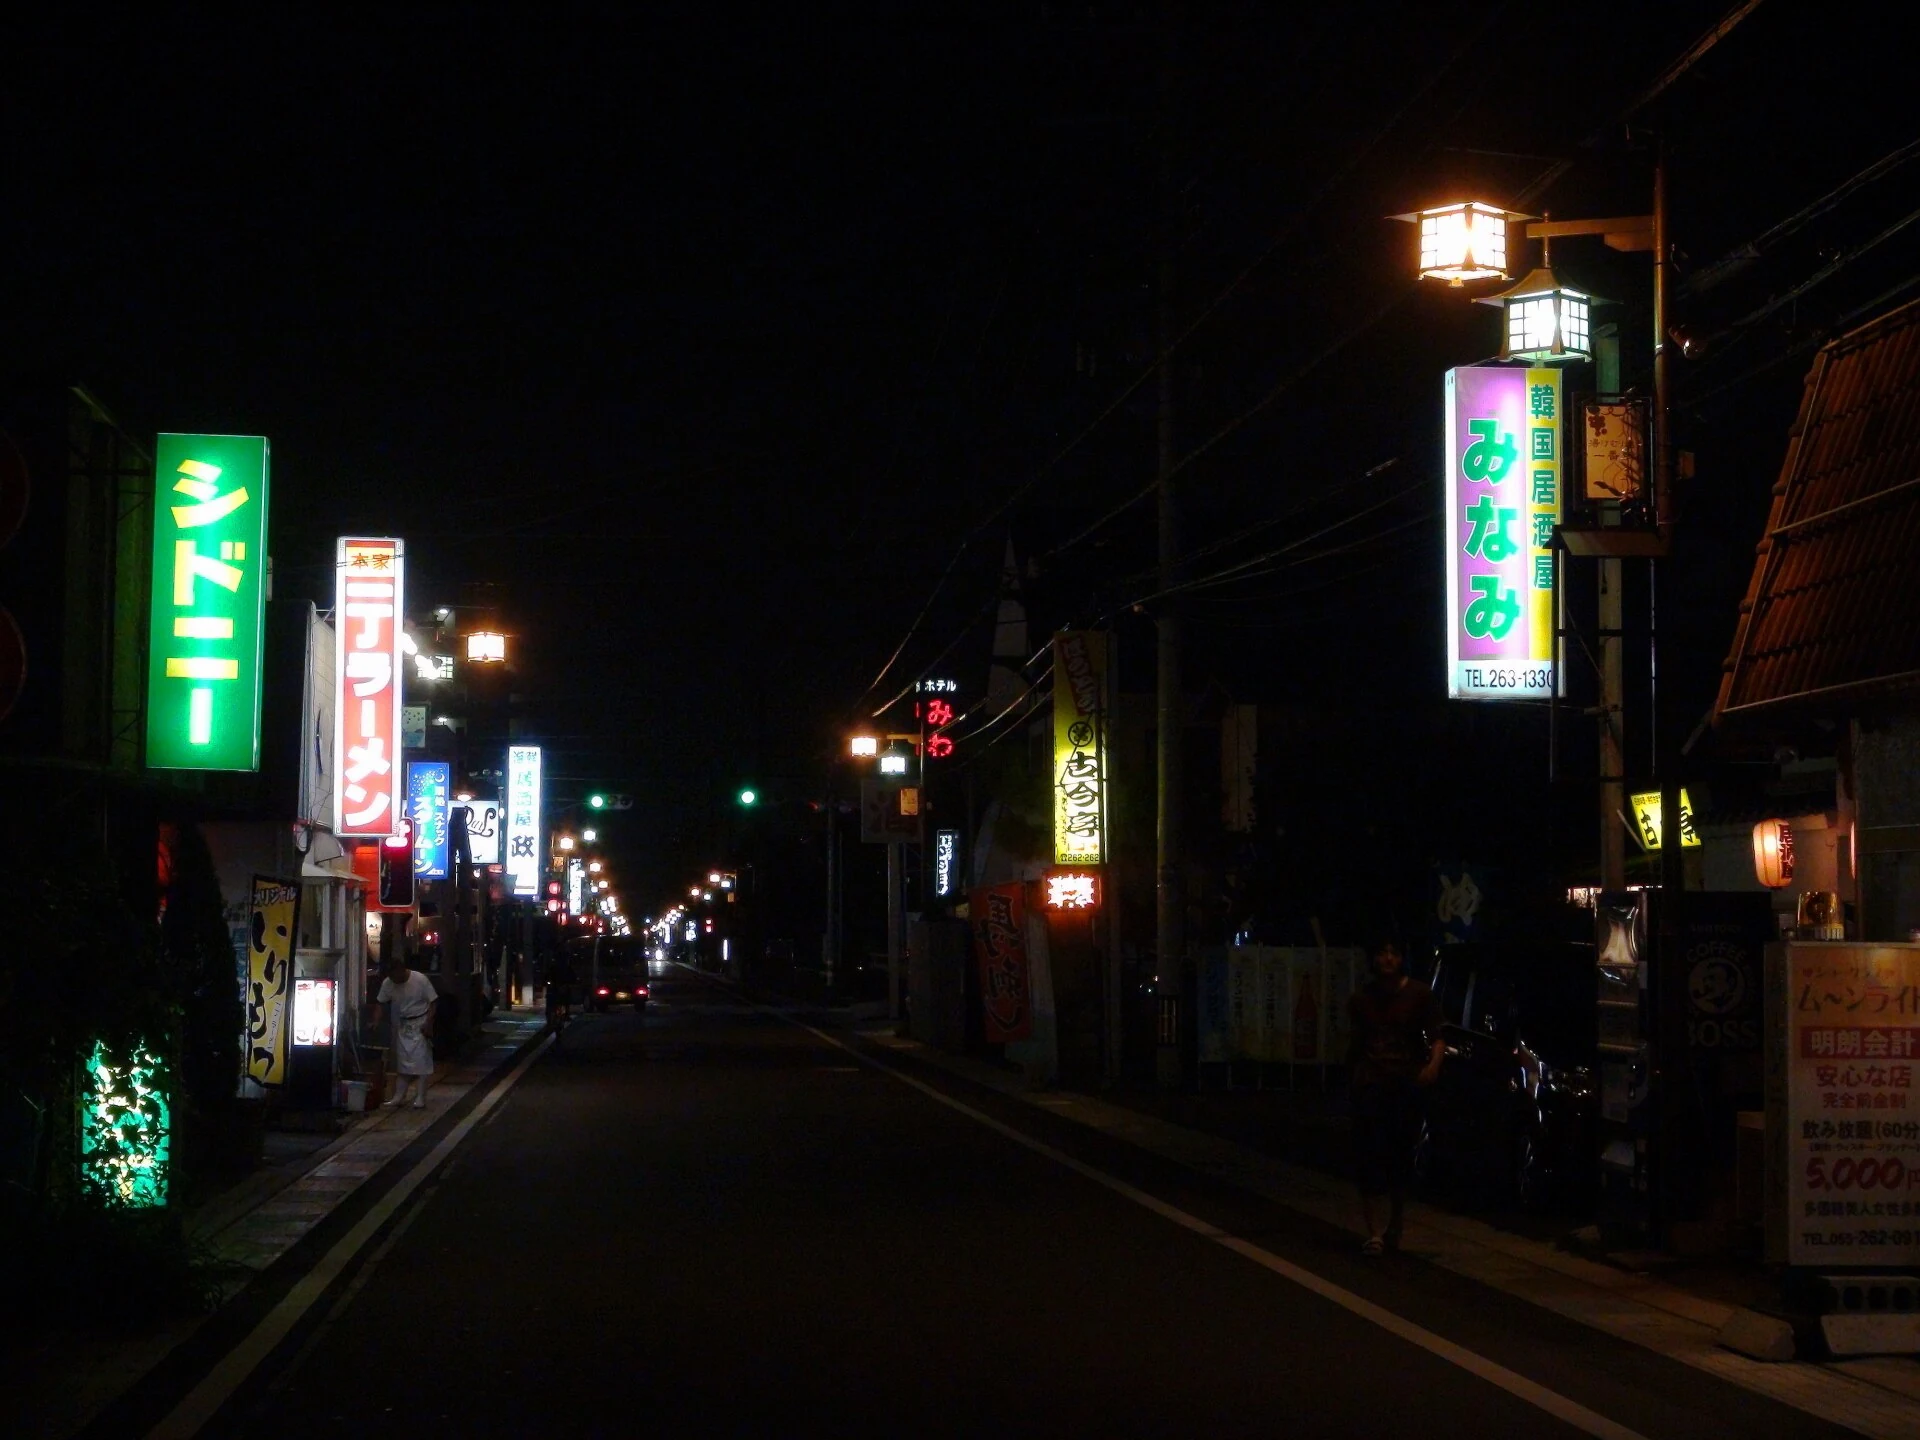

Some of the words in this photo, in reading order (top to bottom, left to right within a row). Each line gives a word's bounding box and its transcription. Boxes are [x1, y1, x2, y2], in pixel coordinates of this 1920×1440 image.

[1531, 384, 1556, 588] 韓国居酒屋
[1462, 418, 1520, 643] みなみ
[351, 553, 390, 570] 本家
[165, 458, 250, 745] シドニー
[925, 680, 956, 692] ホテル
[927, 700, 953, 757] みわ
[434, 811, 445, 846] スナック
[1686, 940, 1748, 963] COFFEE
[1811, 1030, 1917, 1056] 明朗会計
[1816, 1065, 1912, 1087] 安心な店
